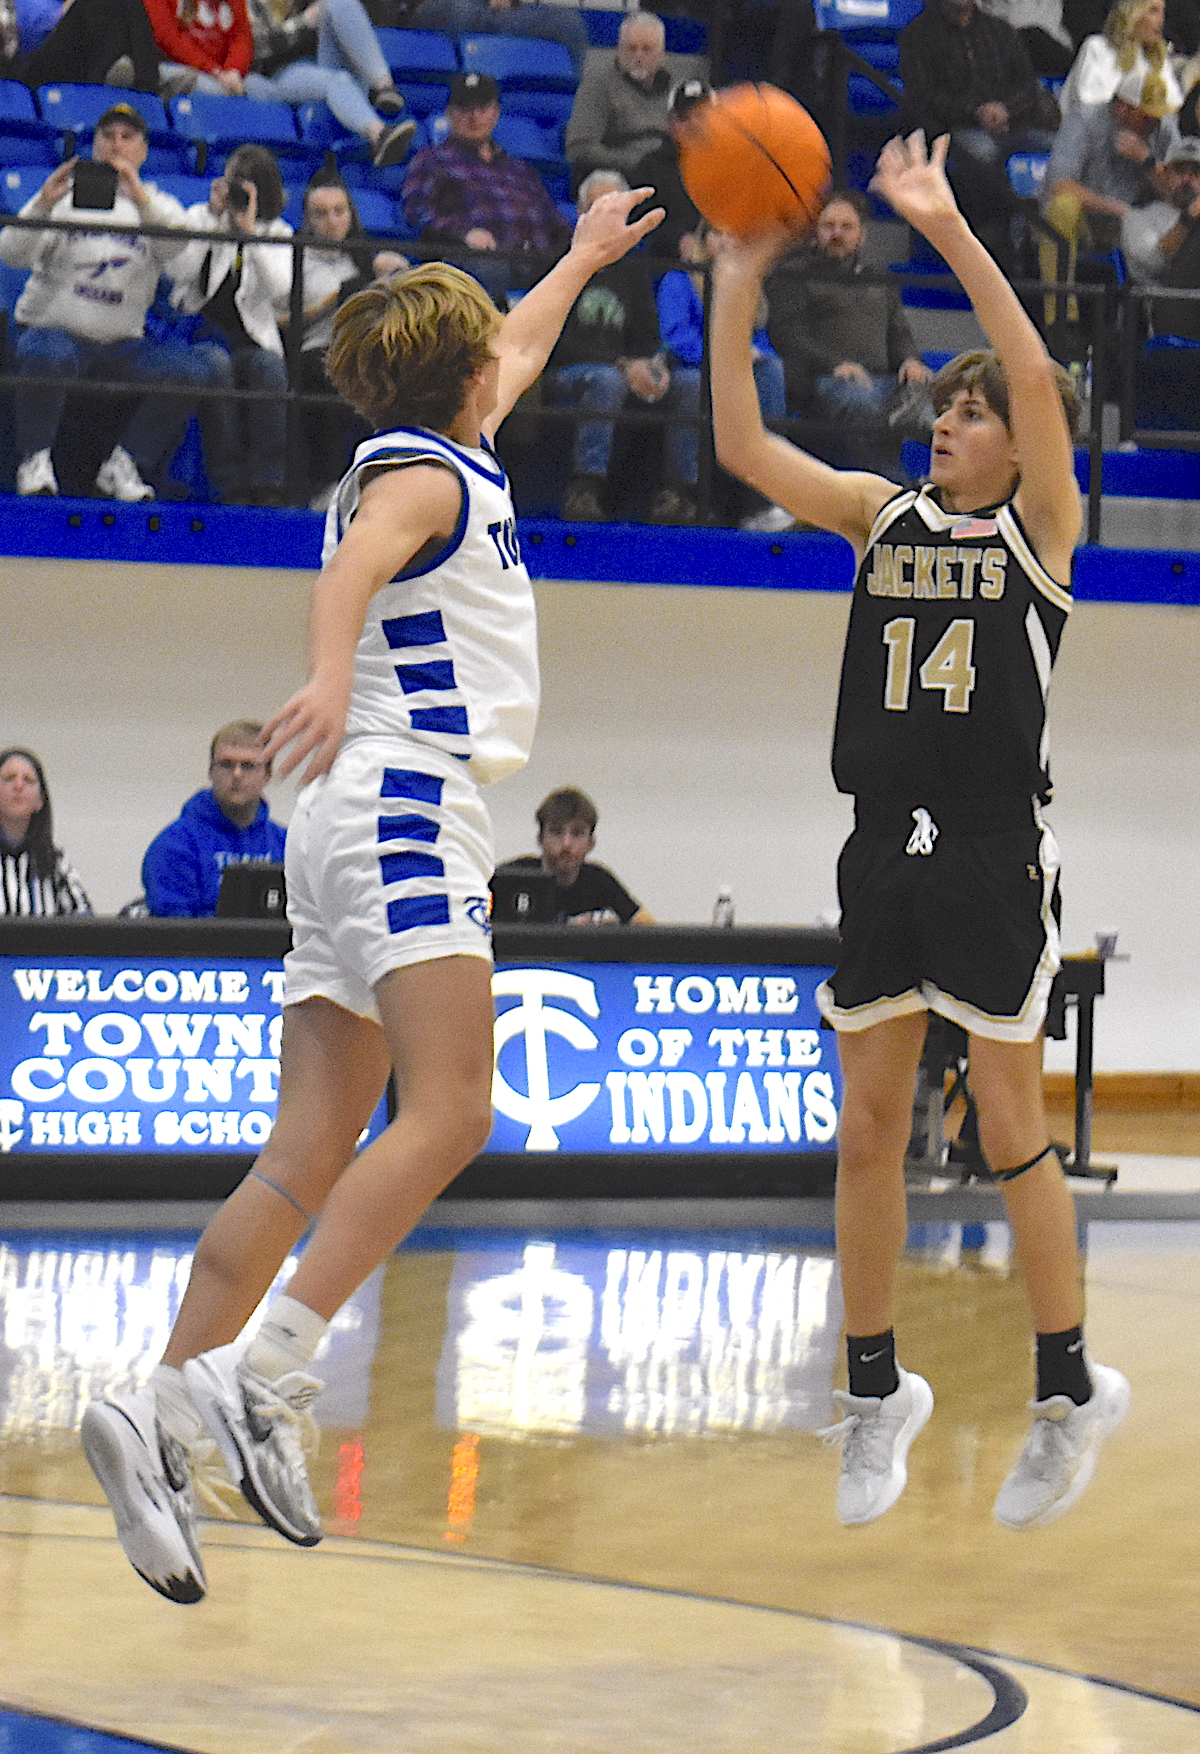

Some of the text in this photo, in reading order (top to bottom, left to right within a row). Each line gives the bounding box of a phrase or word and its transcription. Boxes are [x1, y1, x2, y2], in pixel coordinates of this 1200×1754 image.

[866, 543, 1008, 600] JACKETS
[882, 617, 977, 713] 14
[13, 969, 250, 1002] WELCOME
[633, 976, 799, 1014] HOME
[617, 1028, 822, 1067] OF THE
[11, 1057, 281, 1102] COUNT
[29, 1110, 273, 1146] HIGH SCHO
[606, 1071, 838, 1144] INDIANS
